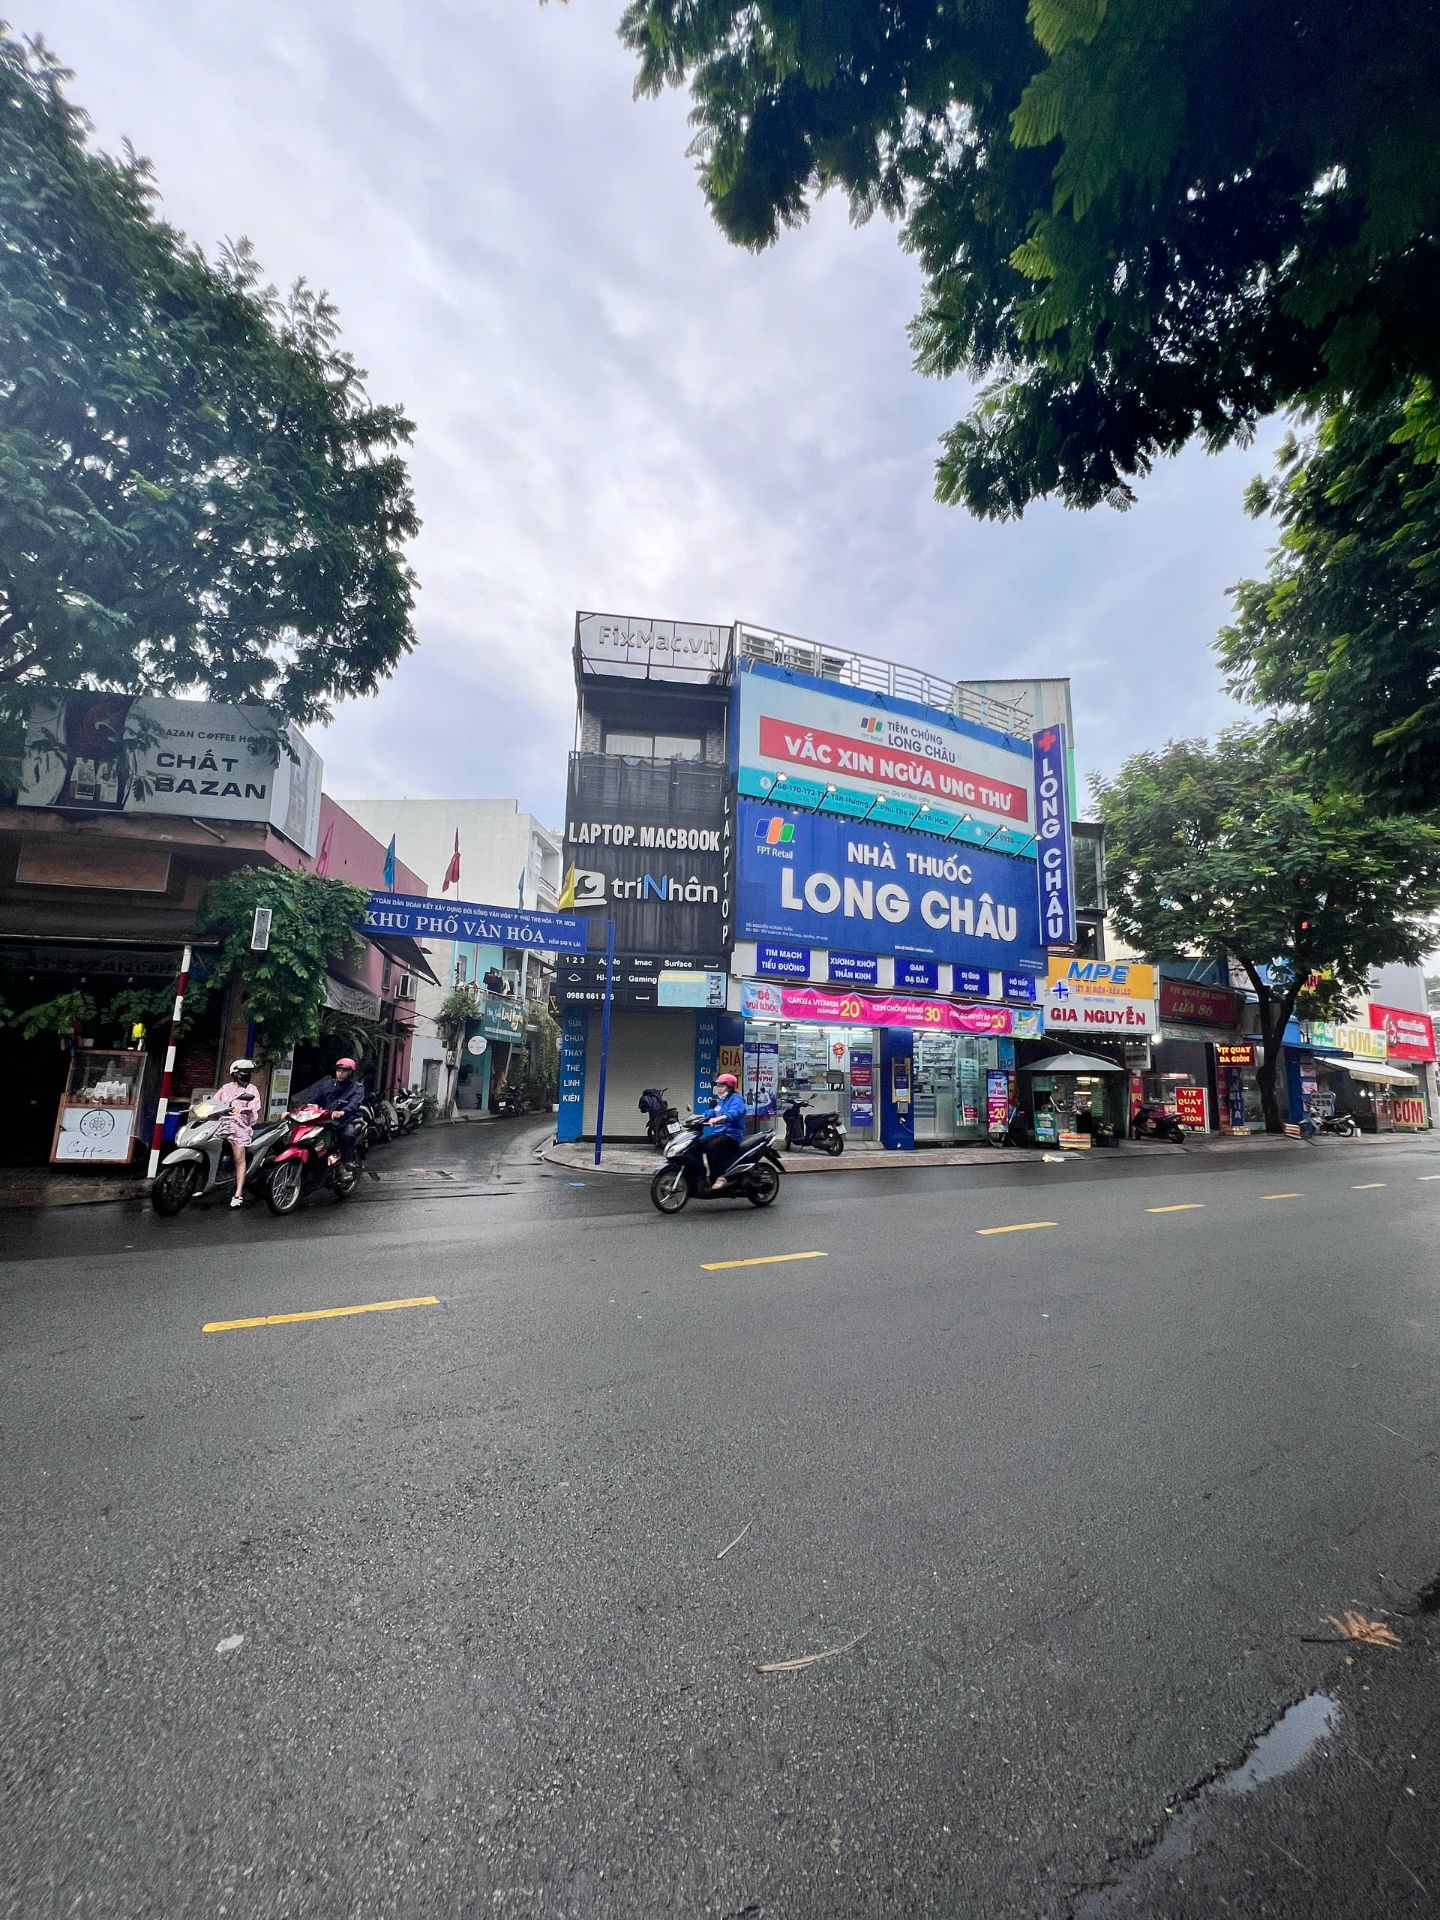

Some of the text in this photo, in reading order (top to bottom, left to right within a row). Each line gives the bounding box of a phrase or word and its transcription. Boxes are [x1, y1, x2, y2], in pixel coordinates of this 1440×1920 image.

[600, 626, 718, 656] FixMac.vn
[887, 721, 908, 734] TIÊM
[159, 729, 194, 738] AZAN
[198, 731, 236, 742] COFFEE
[888, 734, 955, 763] LONG CHÂU
[157, 749, 239, 772] CHẤT
[784, 733, 1012, 811] VẮC XIN NGỪA UNG THƯ
[154, 776, 267, 800] BAZAN
[757, 846, 794, 860] FPT Retail
[1040, 758, 1064, 939] LONG CHÂU
[847, 841, 973, 885] NHÀ THUỐC
[722, 796, 732, 946] LAPTOP
[422, 902, 434, 910] KẾT
[434, 904, 446, 912] XÂY
[781, 867, 1017, 942] LONG CHÂU
[364, 910, 545, 944] KHU PHỐ VĂN HÓA
[765, 949, 802, 960] TIM MẠCH
[664, 960, 692, 968] Surface
[762, 959, 806, 972] TIỂU ĐƯỜNG
[830, 958, 876, 968] XƯƠNG KHỚP
[910, 964, 924, 972] GAN
[834, 969, 871, 980] THẦN KINH
[1066, 961, 1130, 984] MPE
[628, 976, 658, 985] Gaming
[916, 976, 929, 984] DÀY
[566, 992, 584, 1000] 0988
[586, 992, 599, 1000] 661
[787, 996, 808, 1006] CANXI
[813, 999, 839, 1008] VITAMIN
[872, 1004, 886, 1012] KEM
[886, 1004, 907, 1013] CHỐNG
[1050, 1006, 1146, 1026] GIA NGUYỄN
[1338, 1027, 1371, 1054] CƠM
[564, 1049, 584, 1057] THAY
[722, 1048, 740, 1066] GIÁ
[1394, 1100, 1424, 1124] CƠM
